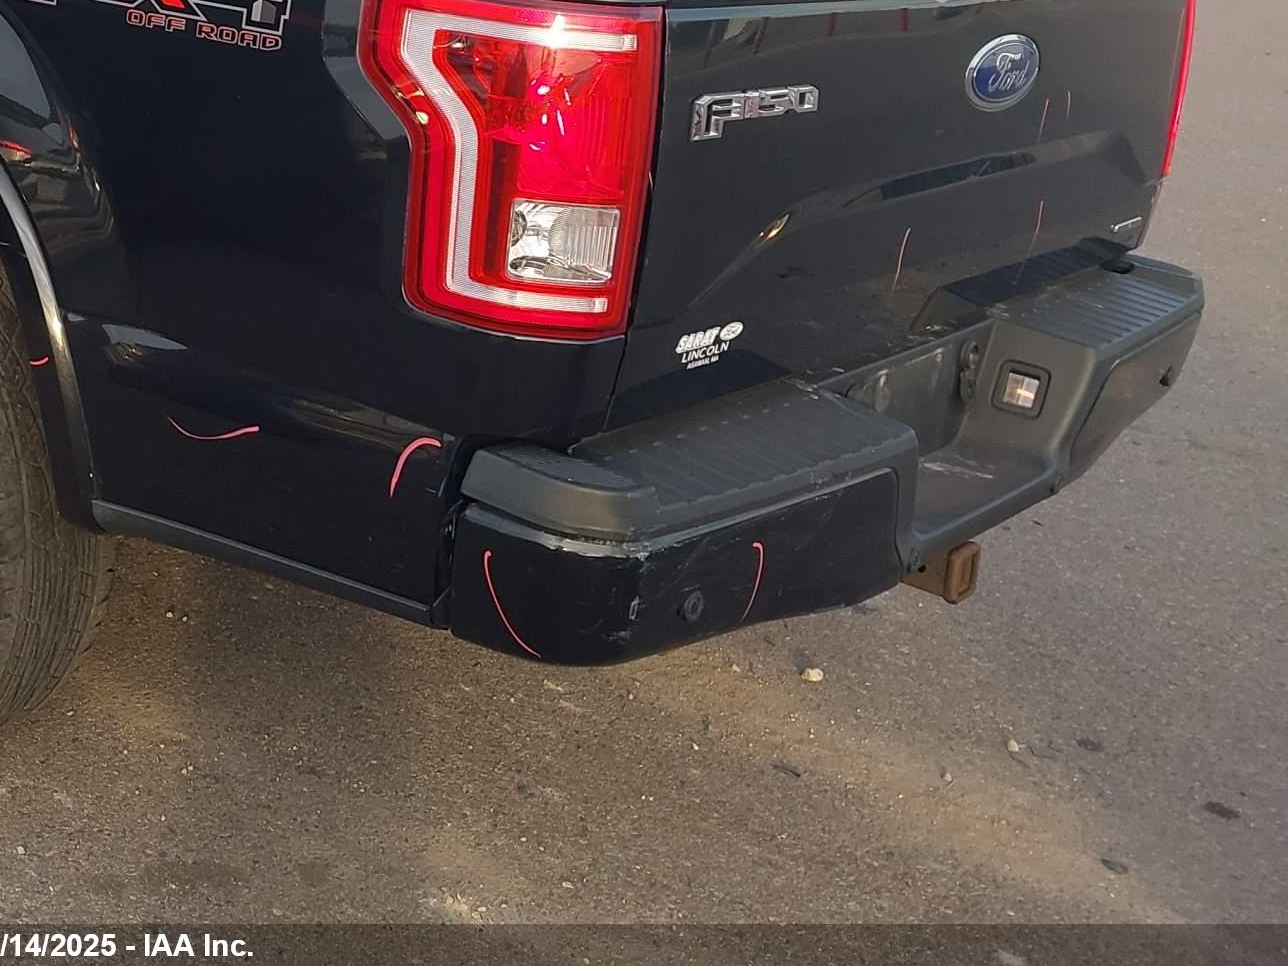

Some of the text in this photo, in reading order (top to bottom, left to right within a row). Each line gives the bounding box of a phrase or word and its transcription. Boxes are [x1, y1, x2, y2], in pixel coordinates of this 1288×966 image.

[126, 9, 282, 51] OFF ROAD
[988, 52, 1030, 92] Ford
[681, 340, 730, 363] LINCOLN
